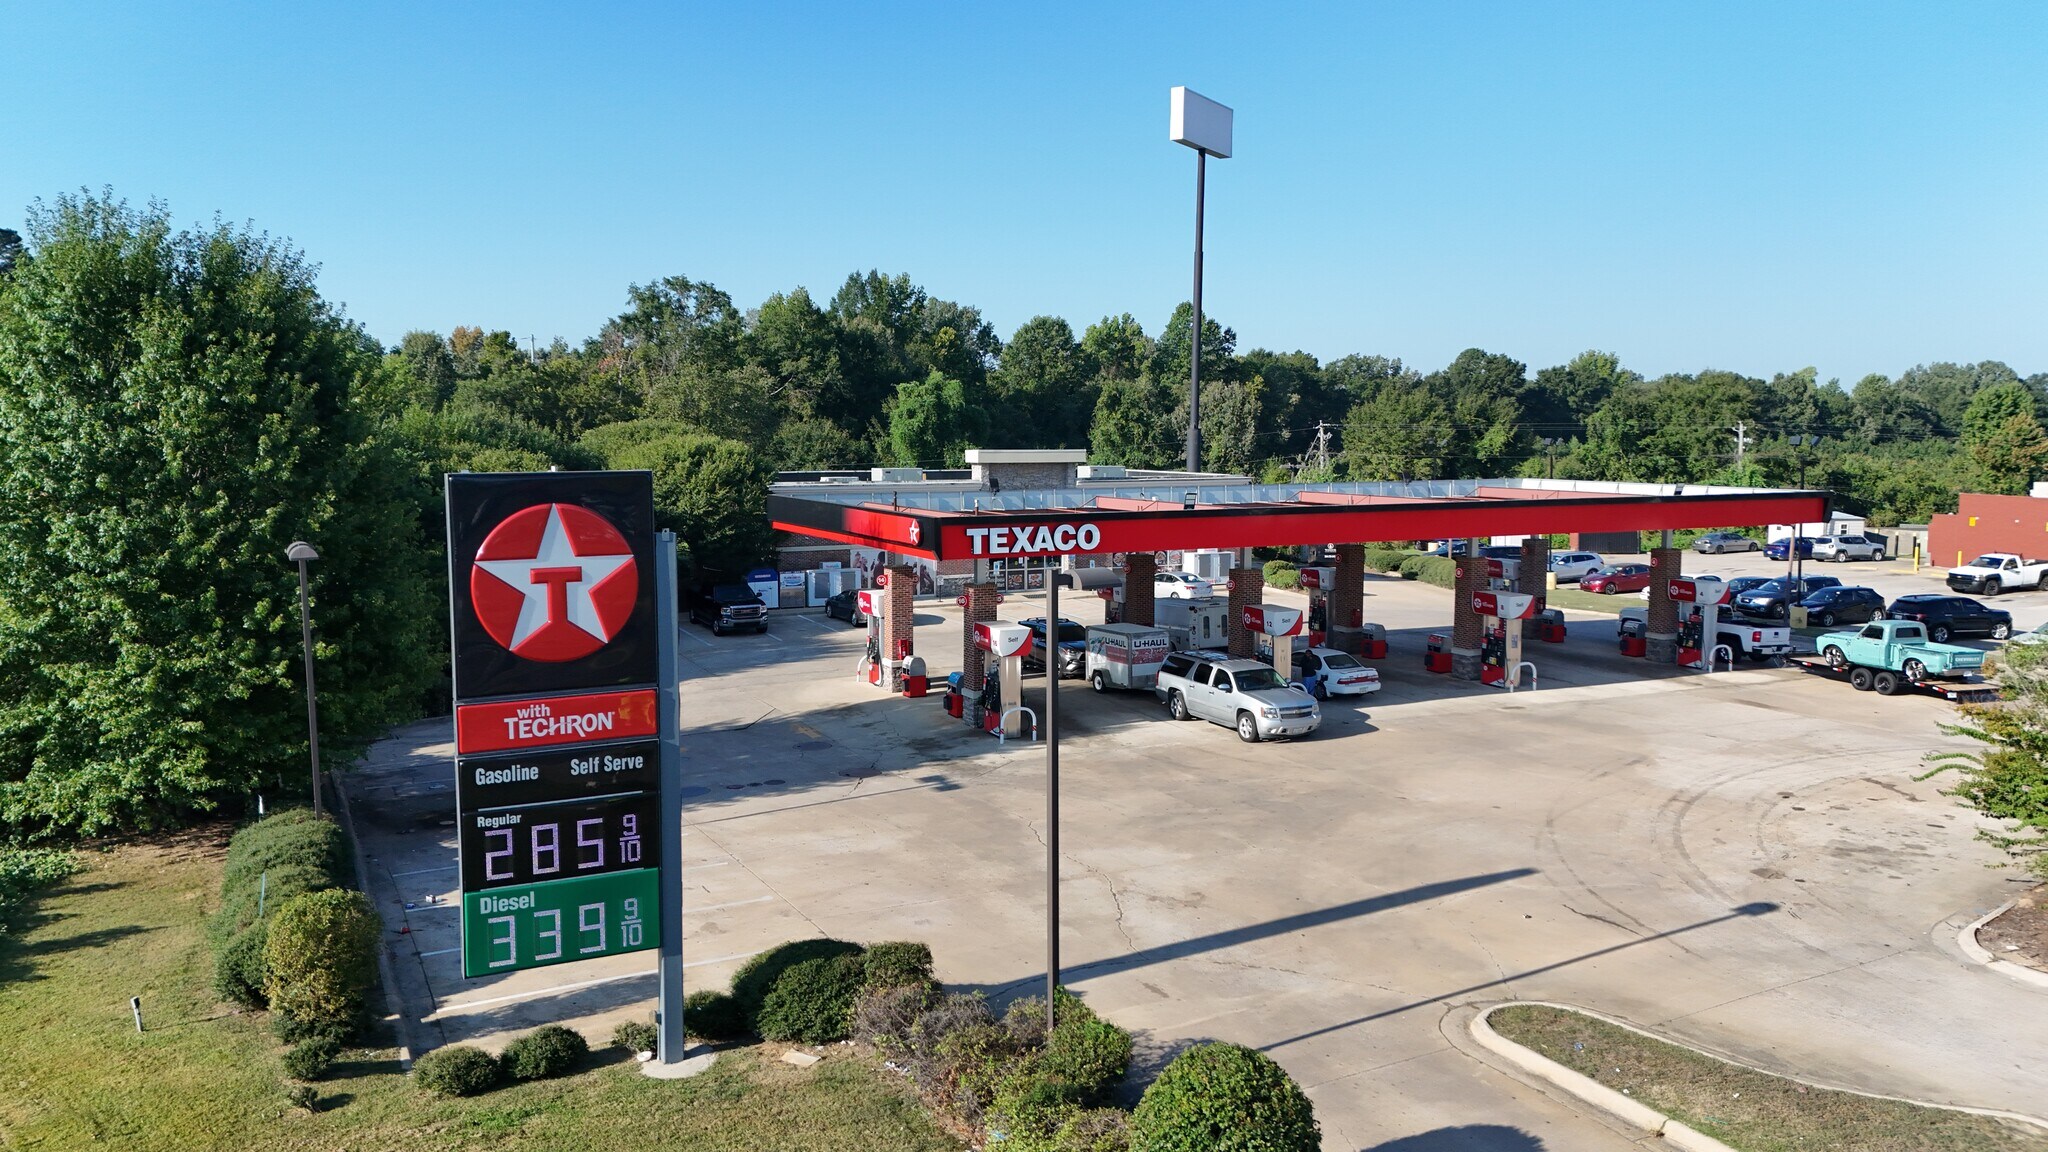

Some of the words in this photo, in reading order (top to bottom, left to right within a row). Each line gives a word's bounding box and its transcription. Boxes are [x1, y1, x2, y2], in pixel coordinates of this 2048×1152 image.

[966, 523, 1101, 555] TEXACO
[1266, 620, 1273, 628] 12
[1104, 637, 1127, 648] U-HAUL
[1133, 637, 1167, 649] U-HAUL
[517, 704, 551, 720] with
[504, 711, 613, 740] TECHRON
[570, 757, 600, 776] Self
[604, 755, 644, 772] Serve
[475, 764, 539, 786] Gasoline
[477, 813, 522, 829] Regular
[480, 891, 535, 915] Diesel
